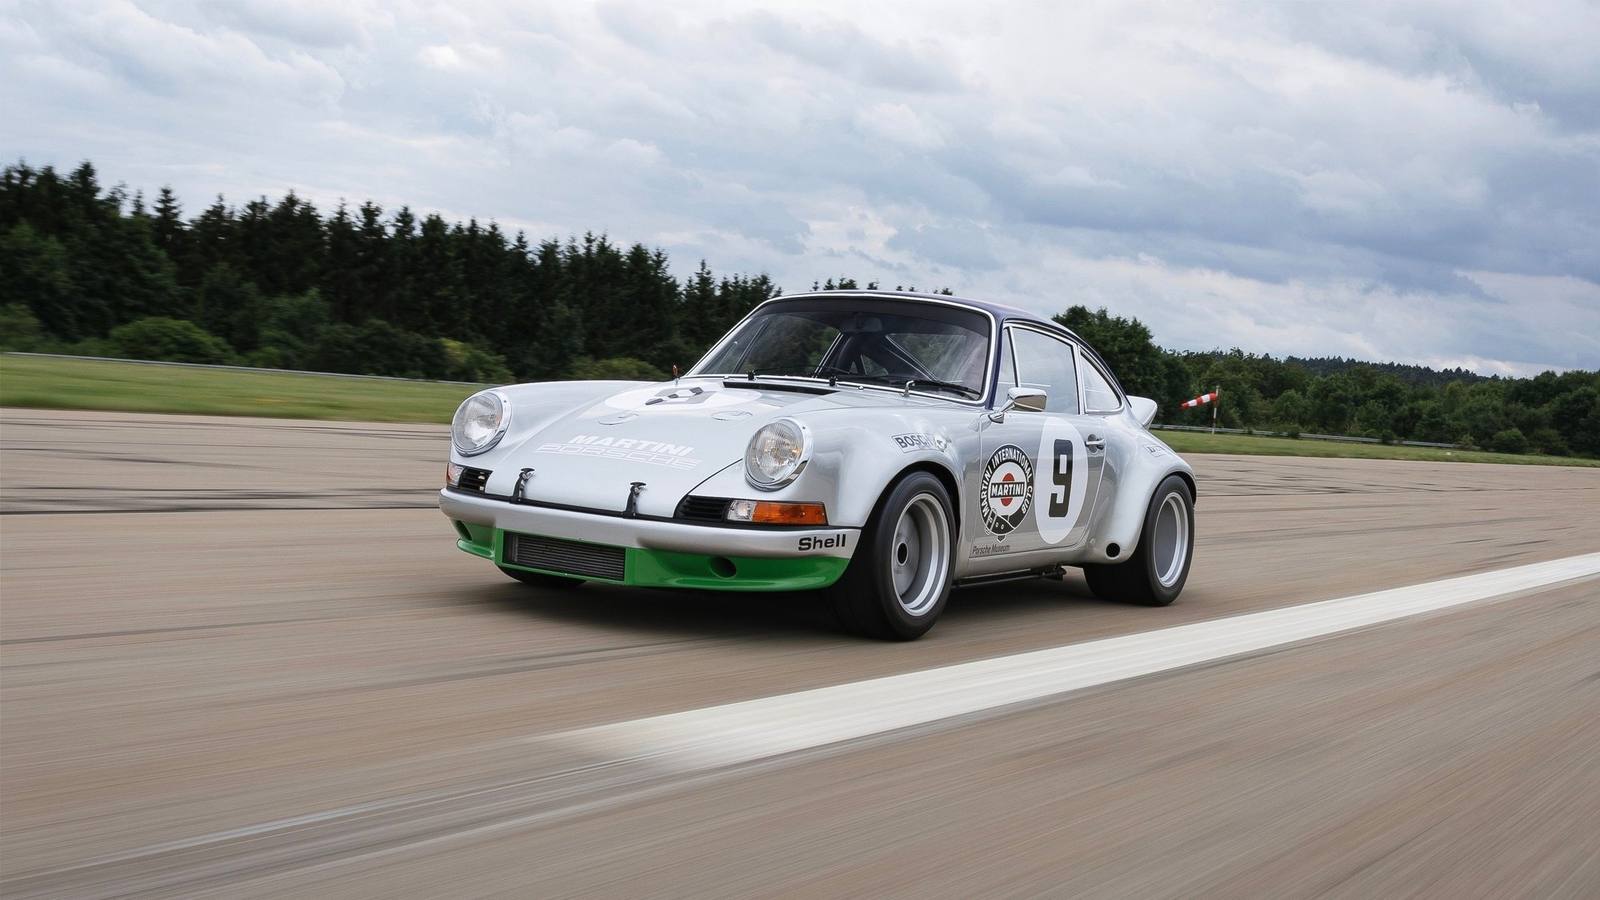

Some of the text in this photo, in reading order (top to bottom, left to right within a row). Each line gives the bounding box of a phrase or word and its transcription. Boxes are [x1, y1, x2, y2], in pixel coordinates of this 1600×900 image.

[536, 442, 702, 470] PORSCHE
[570, 435, 695, 456] MARTINI
[981, 448, 1033, 517] MARTINI INTERNATIONAL CLUB
[1048, 438, 1073, 518] 9
[991, 484, 1024, 498] MARTINI
[798, 533, 846, 551] Shell
[972, 544, 1011, 555] Porsche Museum
